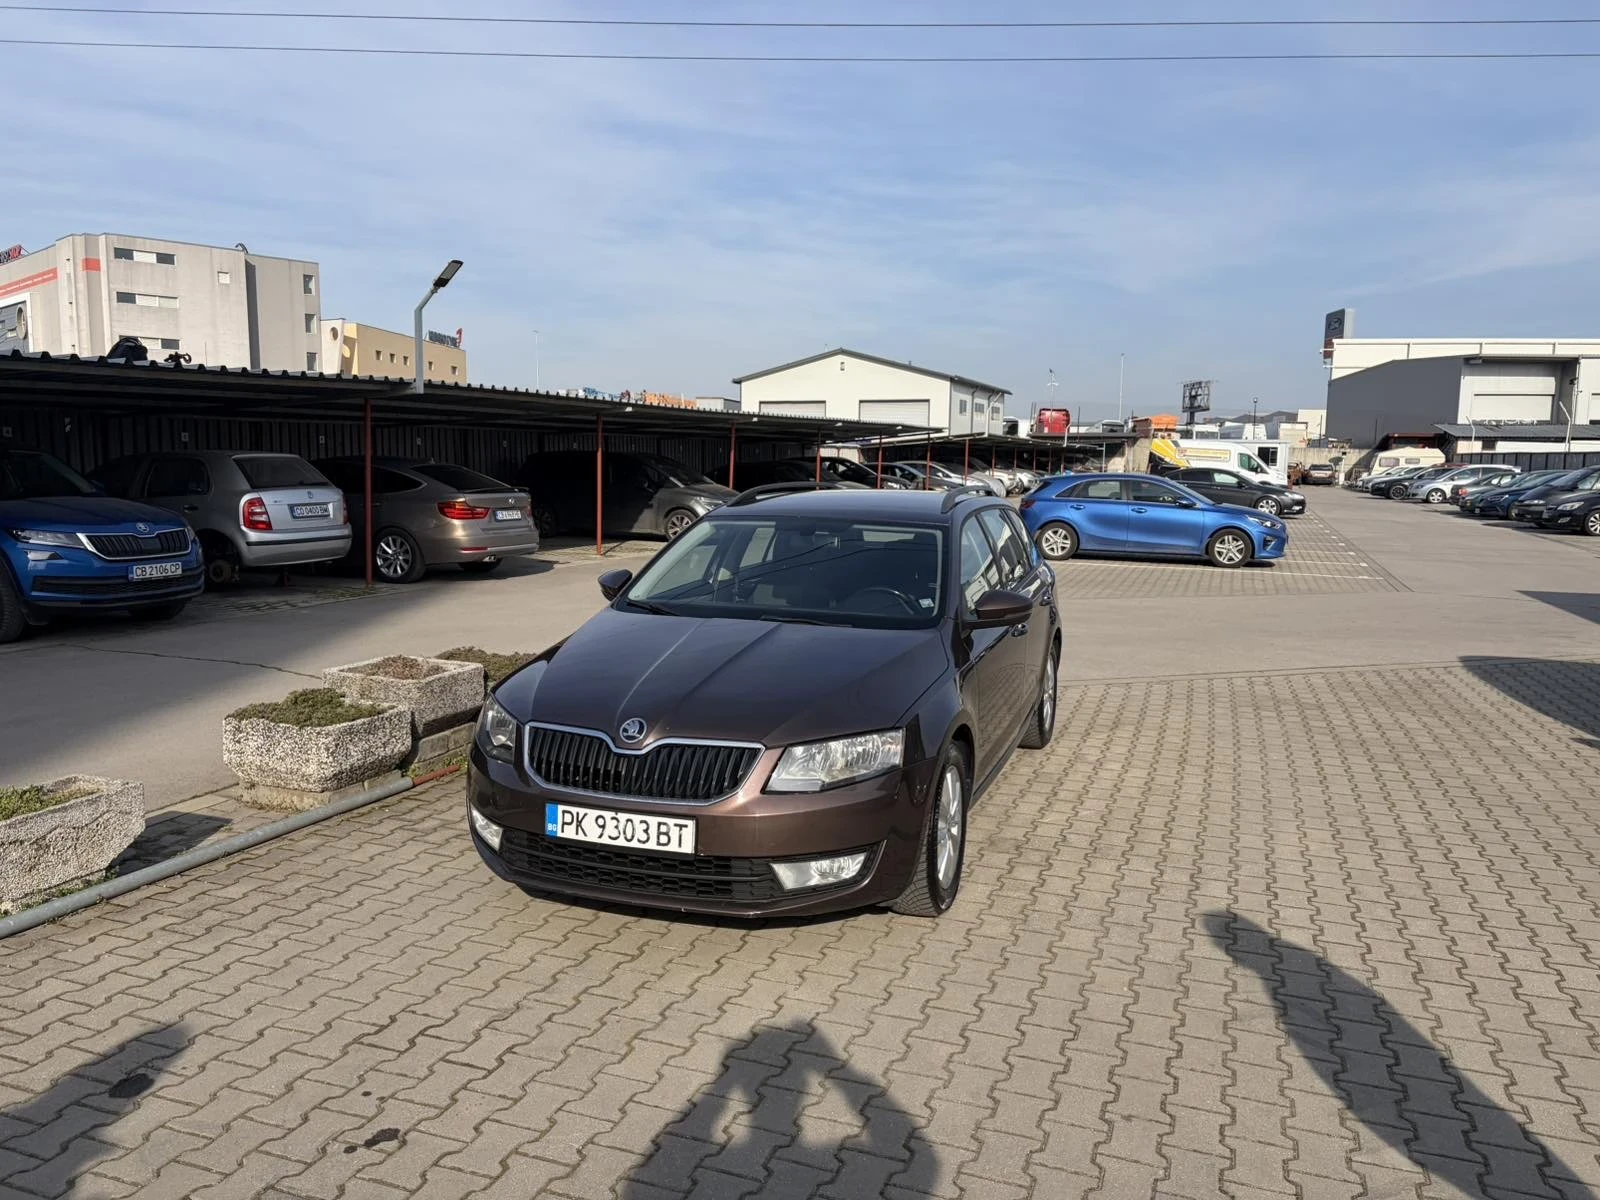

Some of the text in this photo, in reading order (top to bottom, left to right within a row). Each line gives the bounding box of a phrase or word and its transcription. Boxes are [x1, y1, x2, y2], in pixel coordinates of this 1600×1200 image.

[135, 563, 180, 577] CB 2106 CP
[547, 823, 557, 831] BG
[561, 809, 688, 848] PK 9303 BT
